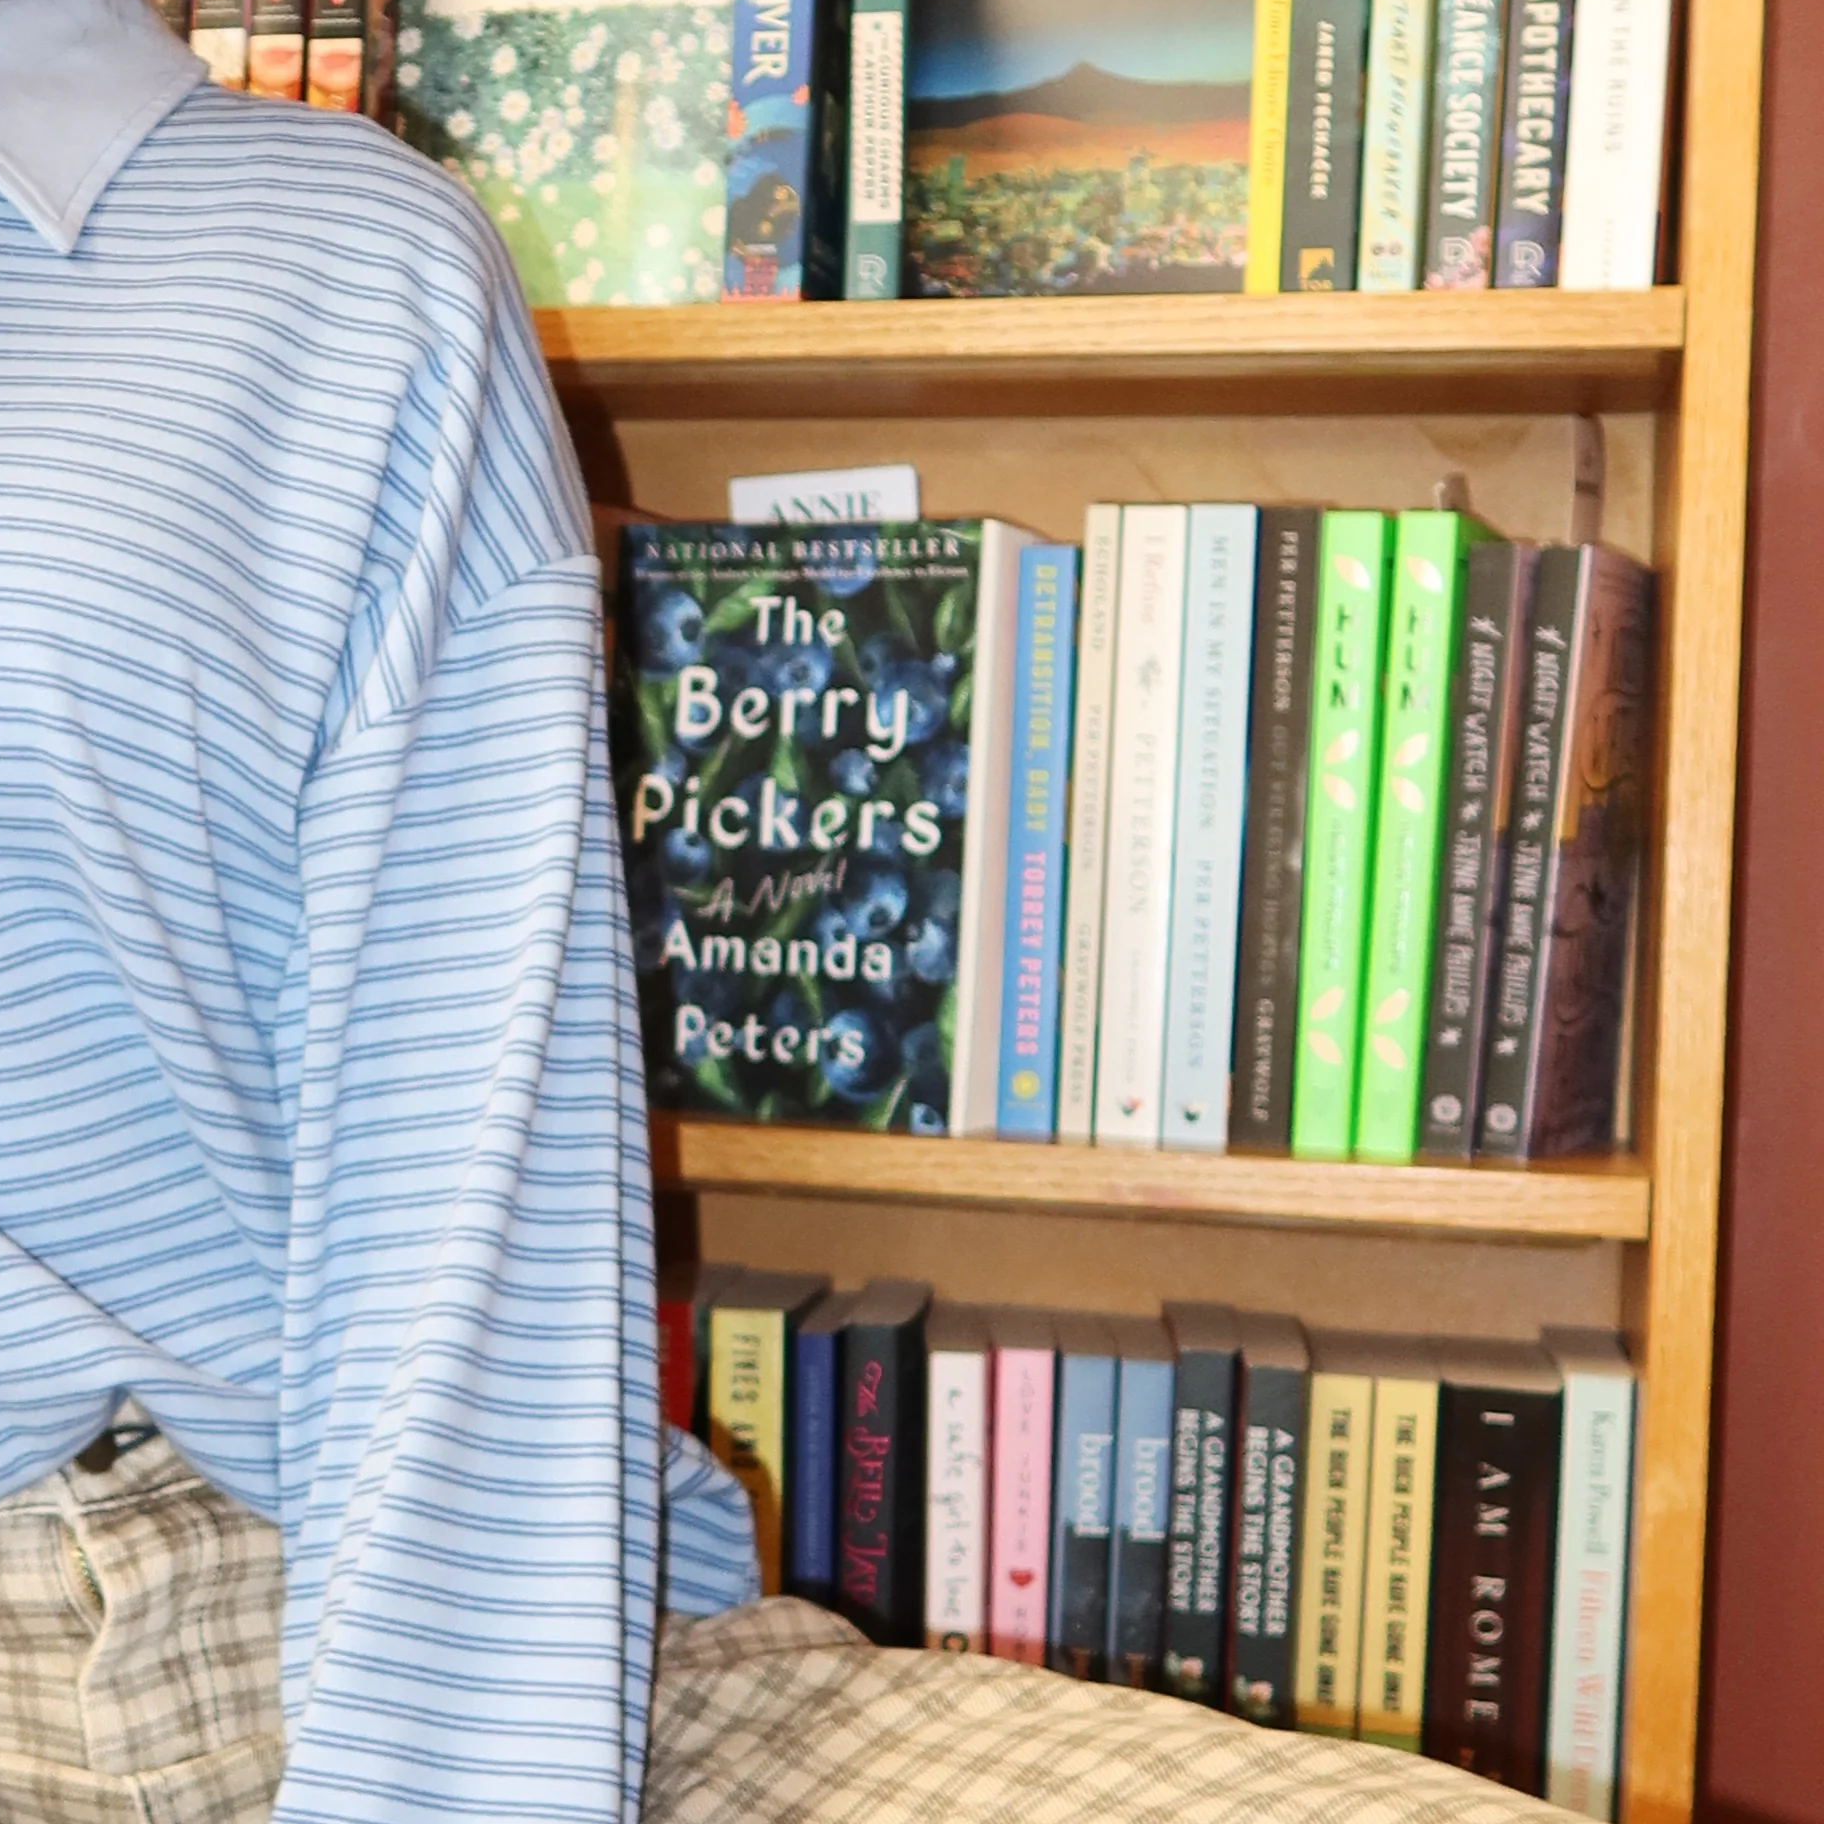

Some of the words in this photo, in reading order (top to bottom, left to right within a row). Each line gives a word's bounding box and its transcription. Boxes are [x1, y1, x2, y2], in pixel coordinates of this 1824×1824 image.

[1315, 21, 1336, 86] JARED
[876, 53, 896, 132] CURIOUS
[875, 138, 895, 211] CHARMS
[1440, 93, 1484, 221] SOCIETY
[771, 489, 881, 523] ANNIE
[645, 539, 780, 561] NATIONAL
[792, 536, 961, 559] BESTSELLER
[1209, 535, 1231, 592] MEN
[749, 595, 848, 647] The
[1209, 600, 1229, 627] IN
[1024, 564, 1058, 760] DETRANSITION,
[1206, 638, 1228, 679] MY
[1465, 641, 1496, 709] NIGHT
[675, 666, 912, 762] Berry
[1198, 686, 1223, 831] SITUATION
[1462, 714, 1491, 793] WATCH
[632, 774, 943, 856] Pickers
[1023, 769, 1049, 832] BABY
[1194, 859, 1215, 906] PER
[1452, 830, 1485, 888] JAYNE
[1019, 851, 1048, 948] TORREY
[1448, 892, 1480, 940] ANNE
[660, 918, 894, 981] Amanda
[1443, 944, 1474, 1018] PHILLIPS
[1015, 956, 1044, 1057] PETERS
[1186, 915, 1212, 1069] PETTERSON
[675, 1004, 867, 1070] Peters
[1175, 1408, 1202, 1486] BEGINS
[1202, 1410, 1226, 1429] A
[1479, 1411, 1516, 1426] I
[1072, 1432, 1109, 1539] brood
[1129, 1437, 1171, 1543] brood
[1174, 1492, 1199, 1534] THE
[1475, 1462, 1512, 1538] AM
[1195, 1436, 1224, 1613] GRANDMOTHER
[1169, 1540, 1197, 1612] STORY
[1464, 1575, 1507, 1724] ROME
